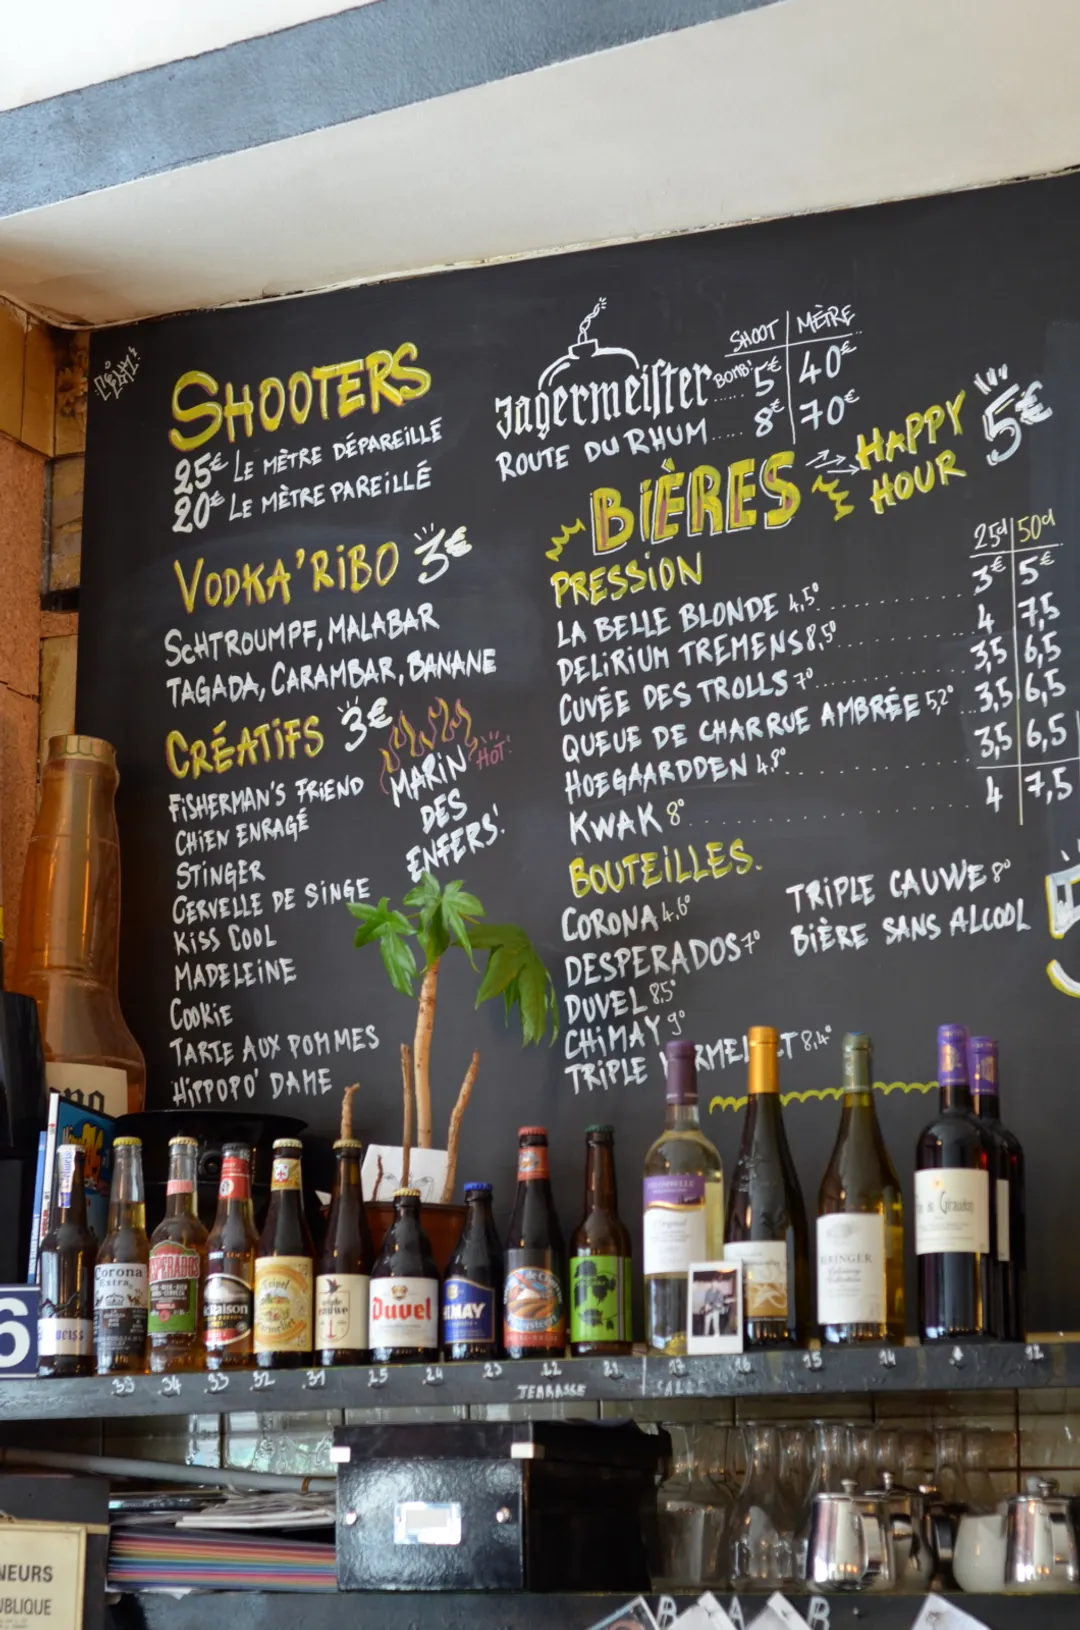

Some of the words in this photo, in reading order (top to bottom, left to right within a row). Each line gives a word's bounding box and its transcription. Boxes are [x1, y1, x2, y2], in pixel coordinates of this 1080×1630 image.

[730, 318, 779, 352] SHOOT
[796, 304, 856, 334] MÈTRE
[169, 342, 432, 451] SHOOTERS
[495, 445, 570, 482] ROUTE
[584, 435, 620, 463] DU
[623, 417, 708, 455] RHUM
[855, 389, 966, 470] HAPPY
[263, 447, 322, 476] MÈTRE
[870, 450, 967, 514] HOUR
[261, 483, 325, 514] MÈTRE
[550, 551, 703, 608] PRESSION
[328, 602, 440, 645] MALABAR
[557, 620, 588, 648] LA
[593, 607, 672, 643] BELLE
[678, 592, 780, 633] BLONDE
[406, 648, 497, 684] BANANE
[556, 644, 670, 687] DELIRIUM
[677, 629, 804, 667] TREMENS
[977, 603, 995, 634] 4
[559, 686, 631, 726] CUVÉE
[643, 681, 692, 711] DES
[697, 669, 789, 703] TROLLS
[562, 725, 642, 764] QUEUE
[652, 723, 688, 750] DE
[699, 705, 811, 745] CHARRUE
[820, 686, 921, 728] AMBRÉE
[295, 774, 365, 804] FRIEND
[389, 745, 469, 807] MARIN
[174, 827, 231, 857] CHIEN
[236, 808, 310, 847] ENRAGÉ
[420, 787, 469, 835] DES
[569, 801, 663, 846] KWAK
[986, 775, 1003, 813] 4
[176, 859, 266, 891] STINGER
[785, 873, 876, 913] TRIPLE
[889, 858, 987, 899] CAUWE
[172, 893, 264, 925] CERVELLE
[272, 887, 296, 913] DE
[303, 876, 372, 910] SINGE
[562, 904, 659, 942] CORONA
[173, 925, 222, 957] KISS
[228, 923, 278, 952] COOL
[790, 916, 869, 957] BIÈRE
[882, 912, 941, 945] SANS
[950, 898, 1032, 936] ALCOOL
[174, 957, 298, 992] MADELEINE
[564, 932, 742, 988] DESPERADOS
[564, 986, 649, 1025] DUVEL
[169, 1037, 235, 1067] TARTE
[242, 1033, 282, 1063] AUX
[289, 1024, 381, 1060] POMMES
[564, 1015, 661, 1060] CHIMAY
[271, 1068, 333, 1100] DAME
[564, 1056, 649, 1095] TRIPLE
[95, 1266, 143, 1280] Corona
[372, 1296, 432, 1321] Duvel
